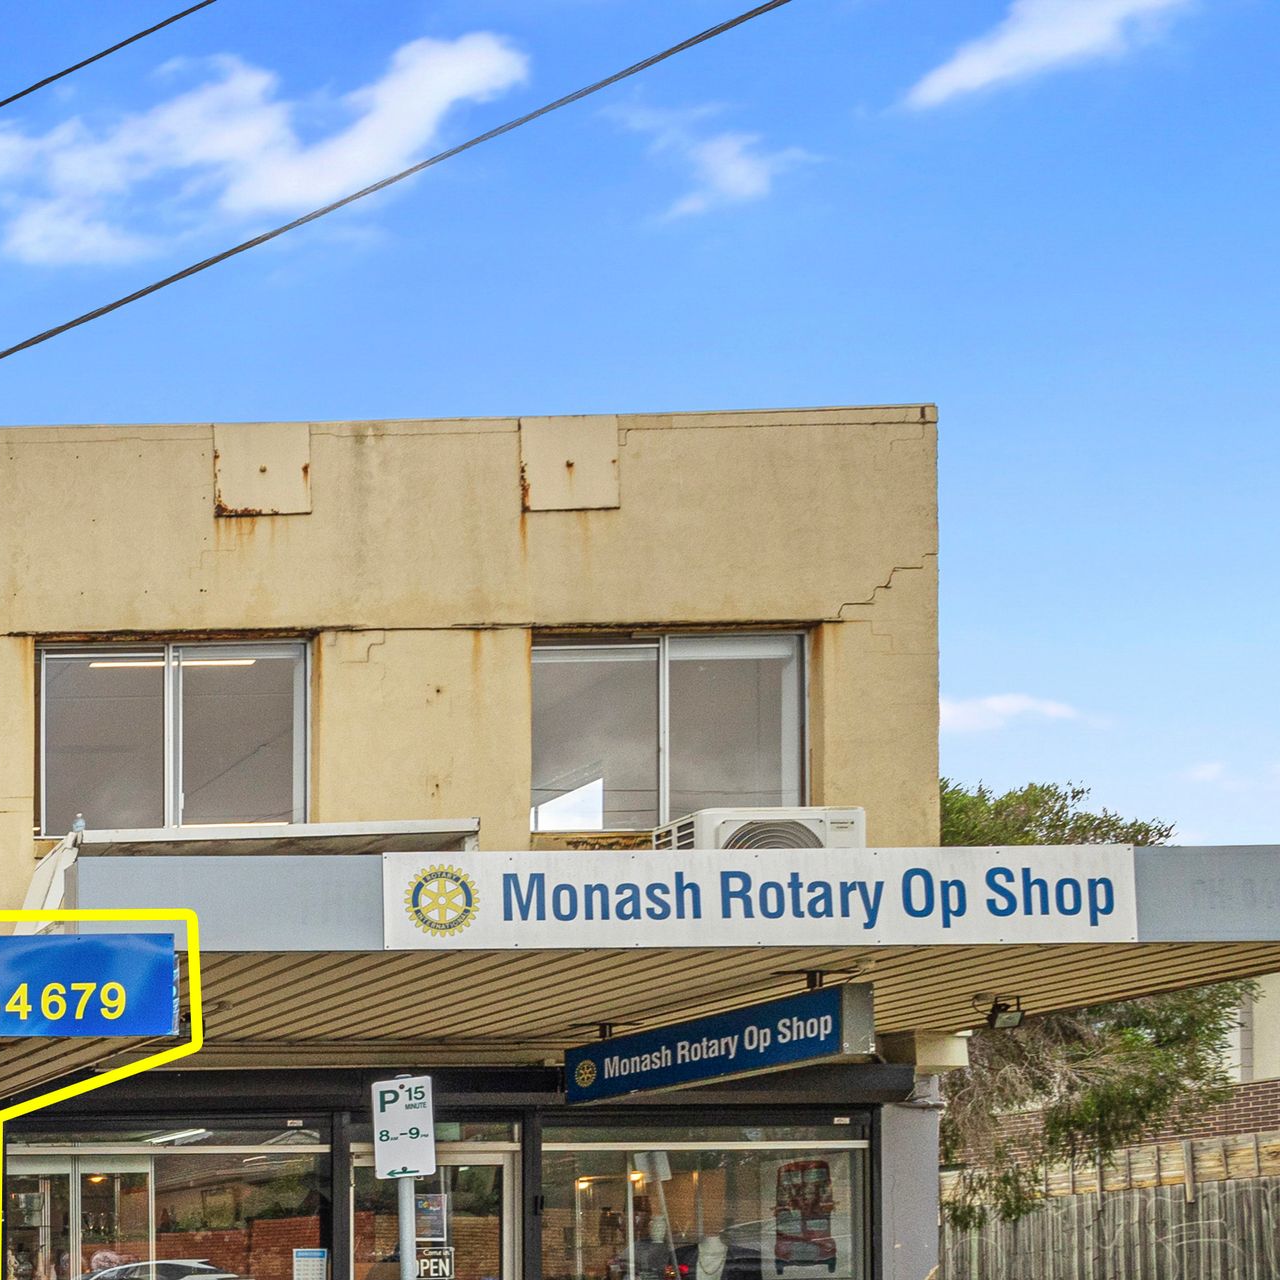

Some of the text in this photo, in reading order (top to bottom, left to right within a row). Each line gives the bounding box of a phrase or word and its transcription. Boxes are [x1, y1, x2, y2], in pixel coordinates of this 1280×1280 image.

[503, 866, 1115, 930] Monash Rotary Op Shop
[40, 981, 126, 1021] 679
[604, 1014, 833, 1079] Monash Rotary Op Shop
[379, 1086, 425, 1113] P 15
[405, 1102, 427, 1110] MINUTE
